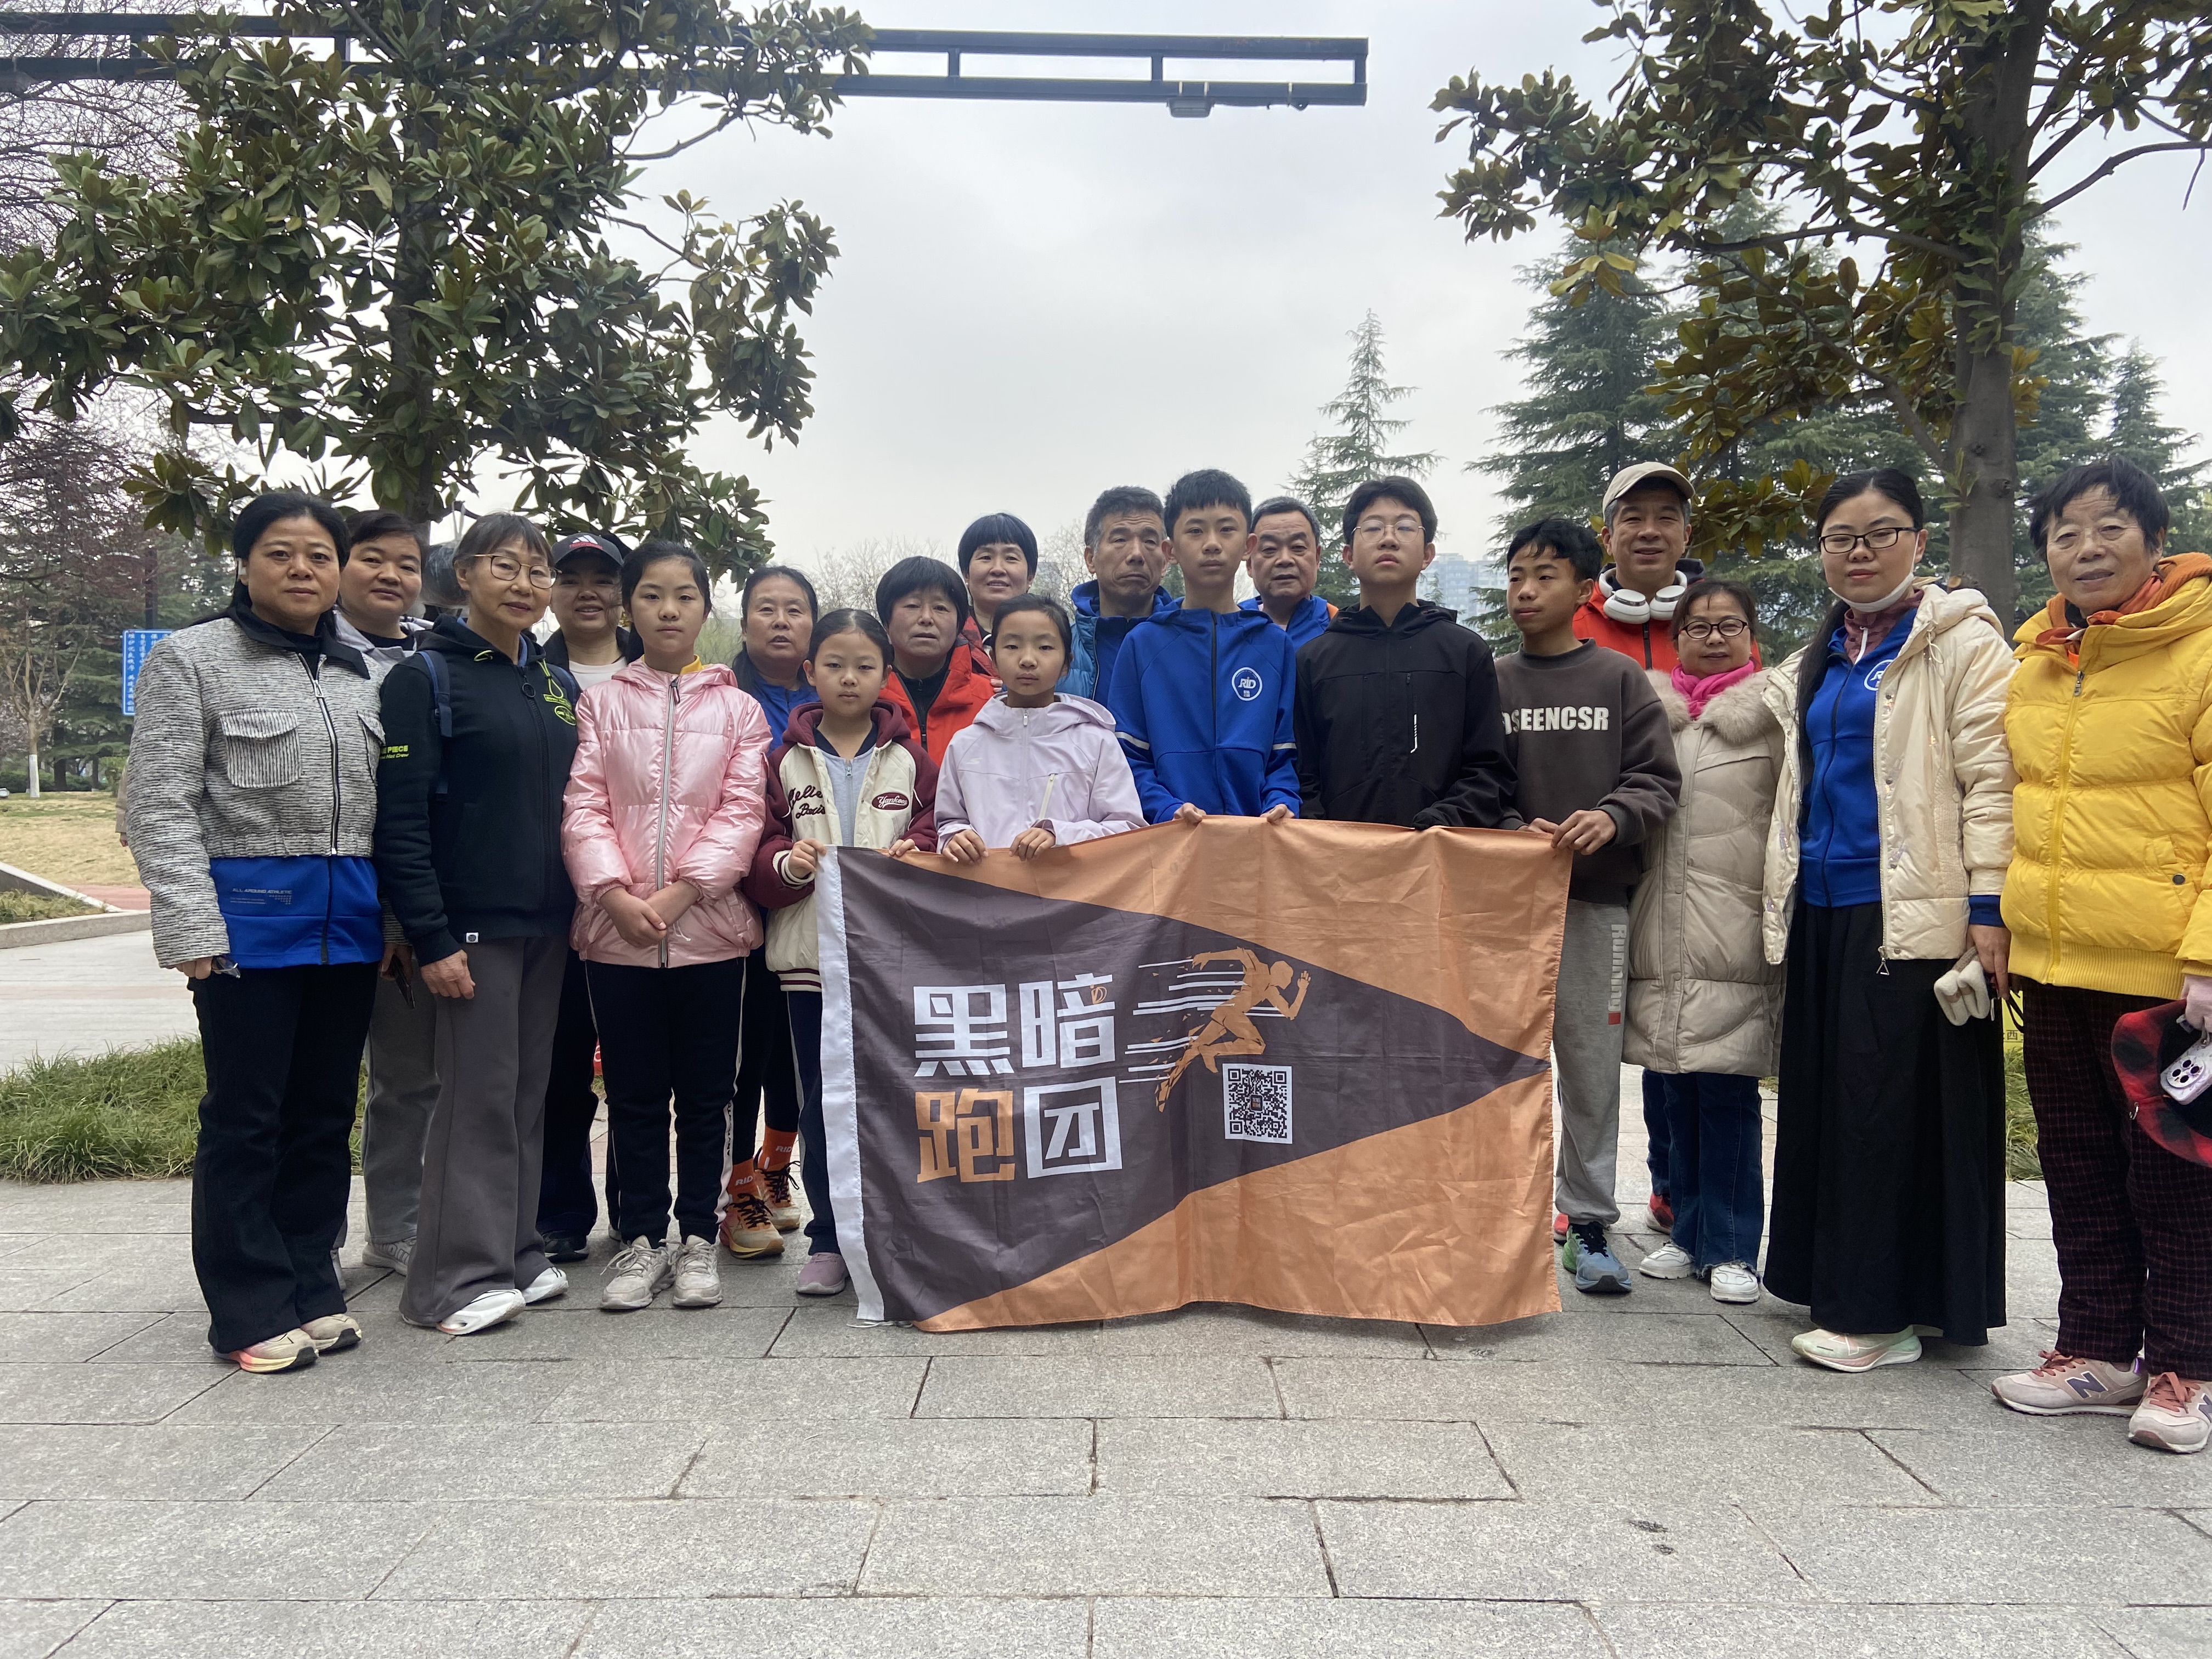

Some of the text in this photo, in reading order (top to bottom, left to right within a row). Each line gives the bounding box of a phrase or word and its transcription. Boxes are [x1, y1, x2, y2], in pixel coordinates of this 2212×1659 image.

[387, 745, 408, 753] PIECE
[1608, 924, 1627, 1012] Running
[914, 973, 1116, 1076] 黑暗
[915, 1076, 1122, 1183] 跑团
[735, 1176, 753, 1186] RID
